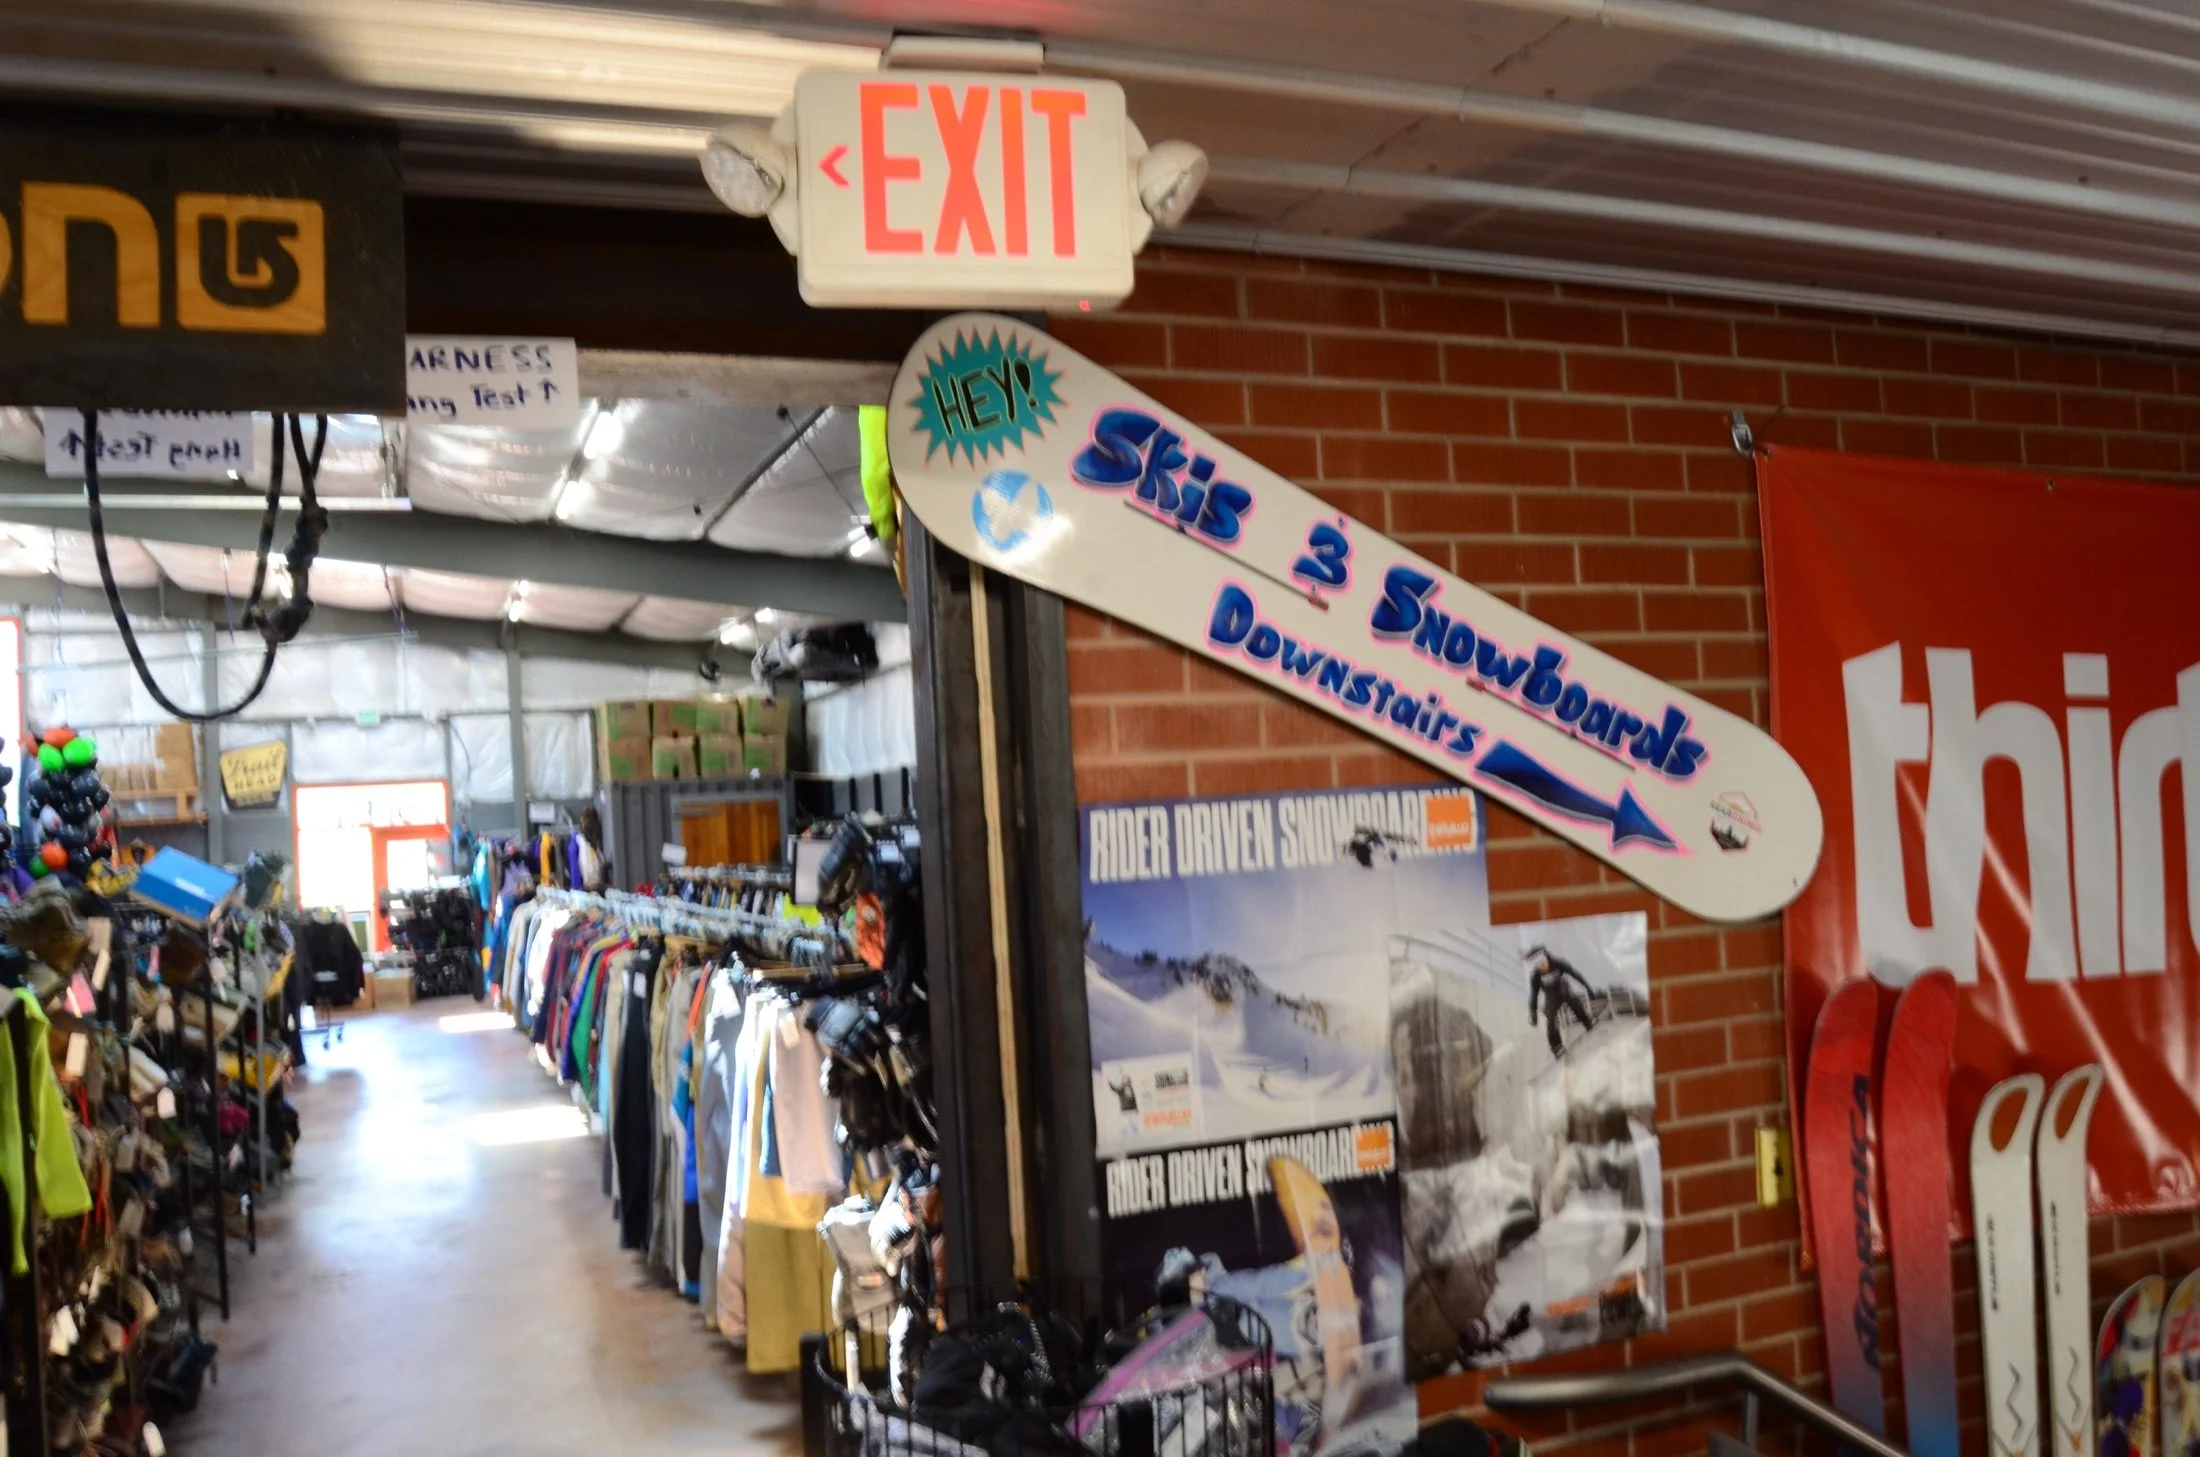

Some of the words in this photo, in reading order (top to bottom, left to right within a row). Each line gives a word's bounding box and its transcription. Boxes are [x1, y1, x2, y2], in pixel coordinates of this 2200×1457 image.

[860, 82, 1087, 258] EXIT
[409, 344, 553, 373] ARNESS
[470, 381, 531, 410] Test
[932, 355, 1038, 440] HEY!
[1071, 406, 1254, 545] Skis
[1208, 583, 1483, 756] Downstairs
[1090, 806, 1171, 884] RIDER
[1174, 799, 1275, 876] DRIVEN
[1106, 1154, 1166, 1219] RIDER
[1168, 1144, 1243, 1206] DRIVEN
